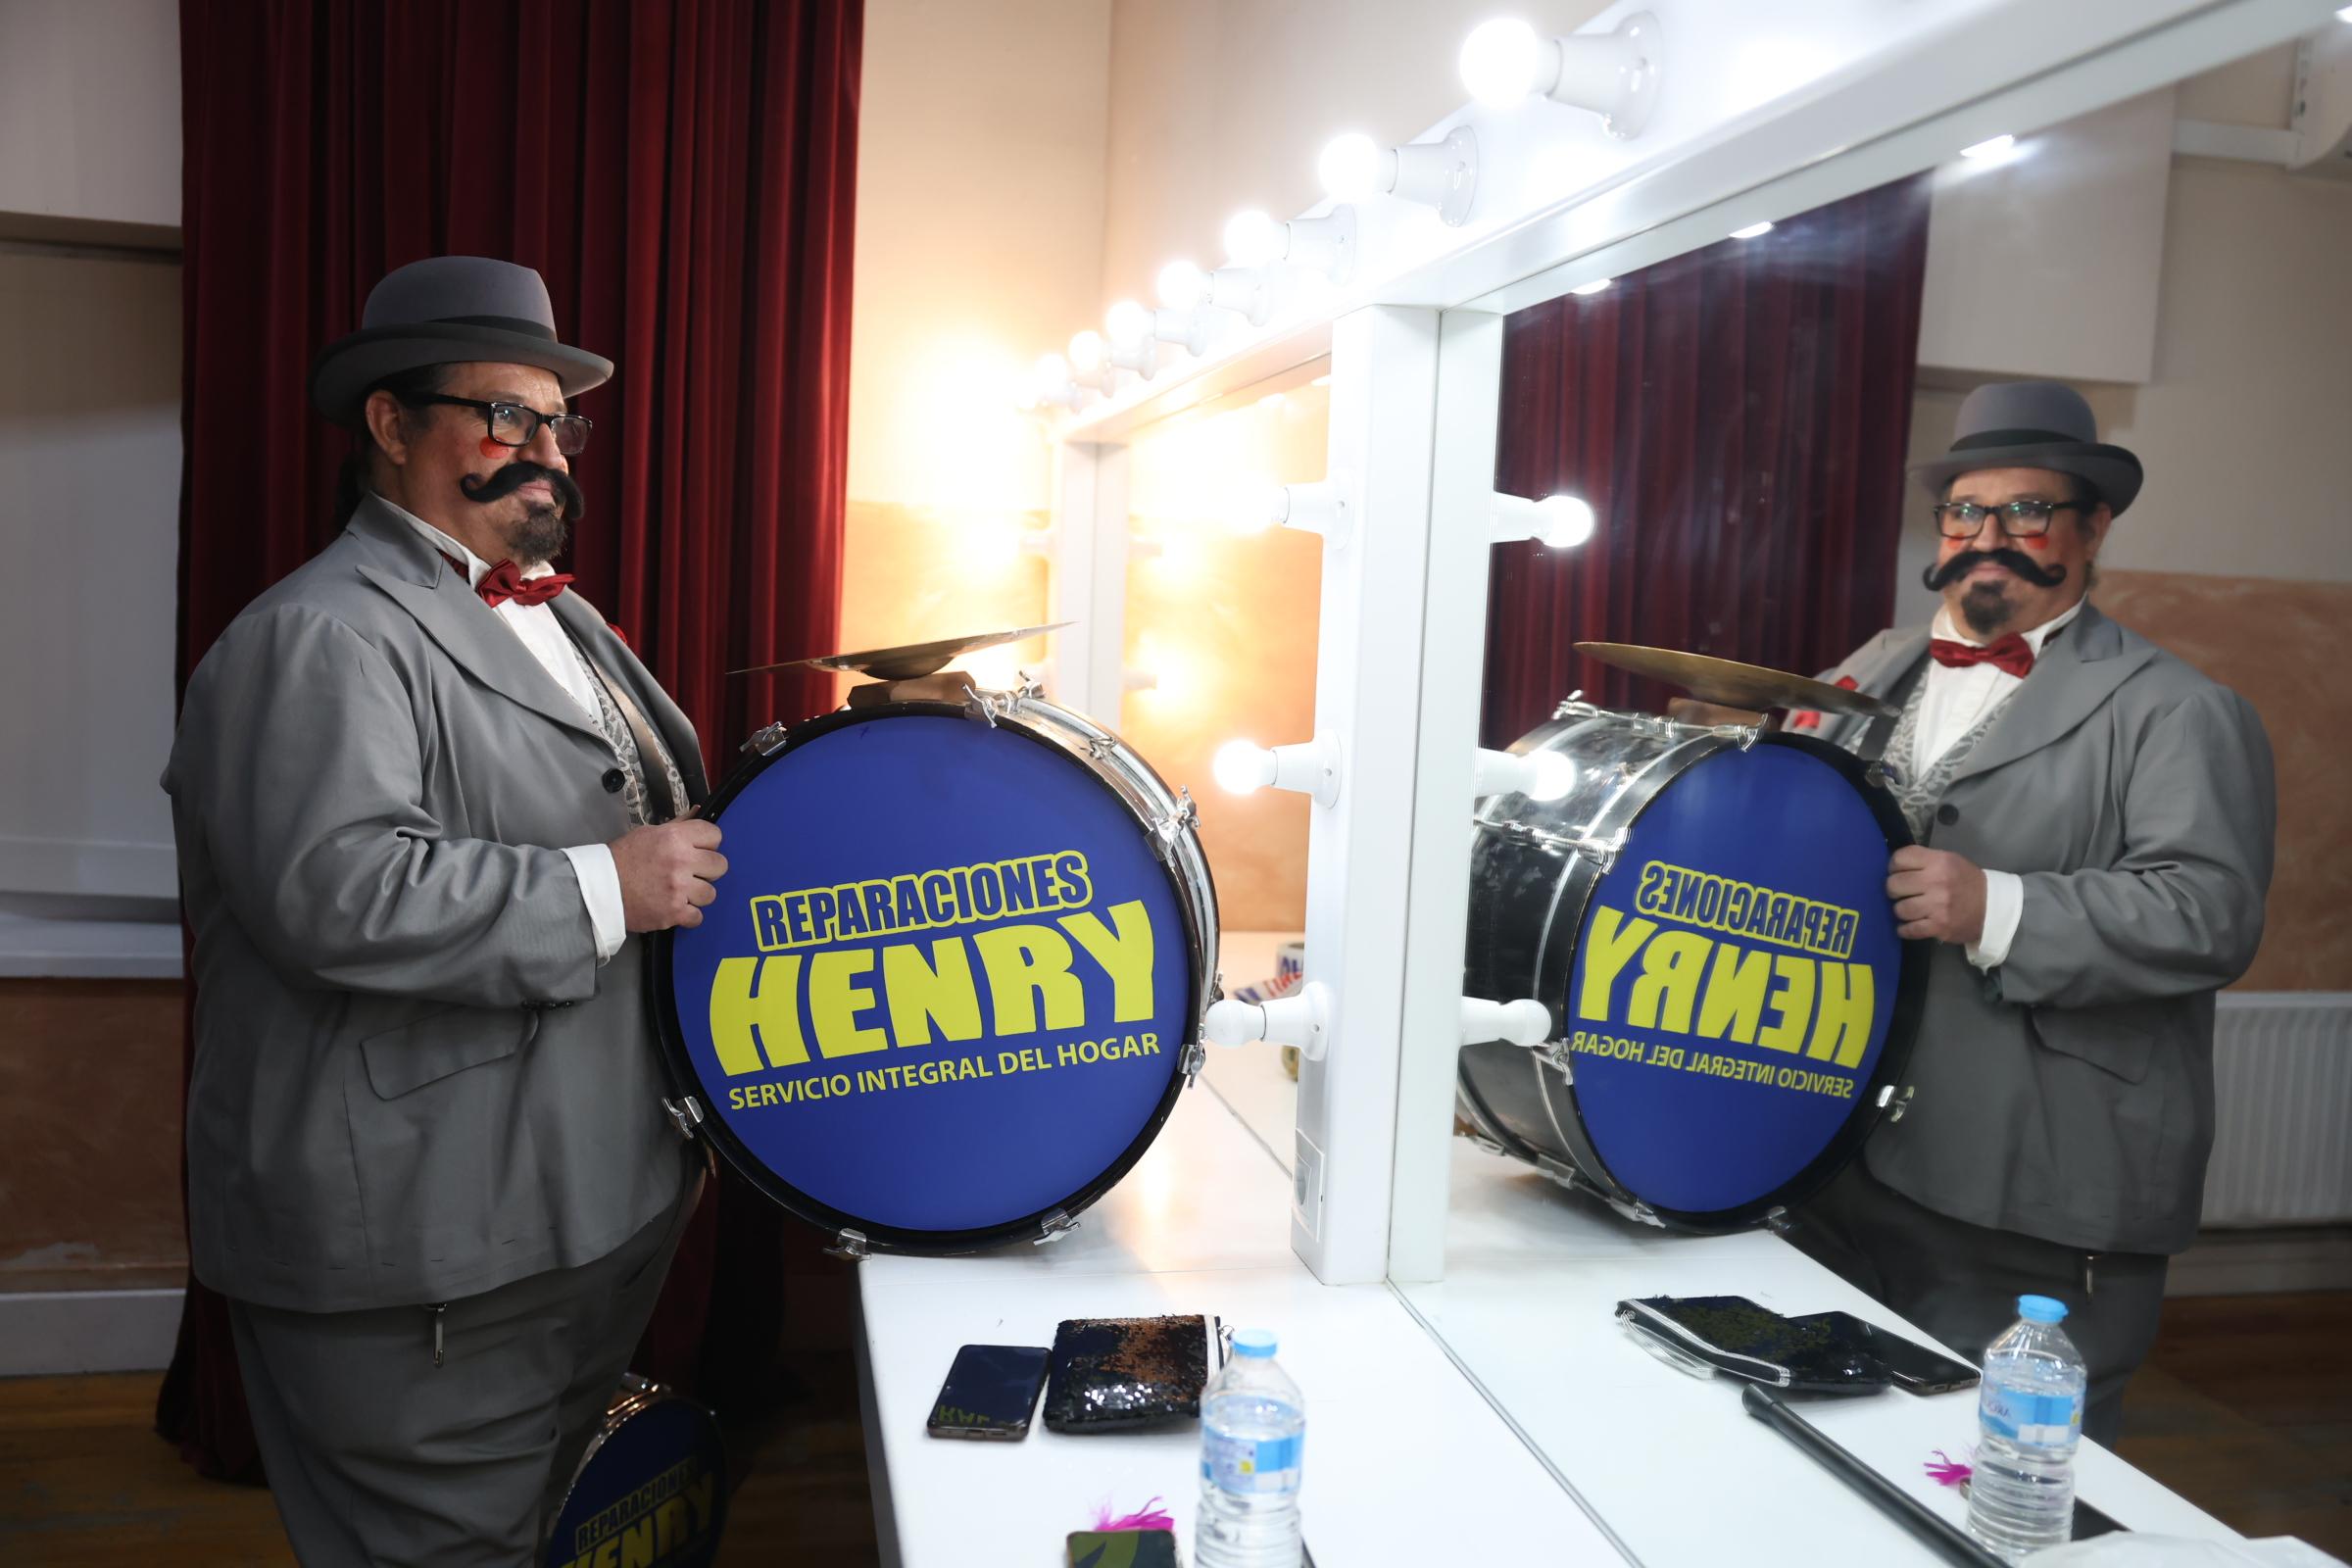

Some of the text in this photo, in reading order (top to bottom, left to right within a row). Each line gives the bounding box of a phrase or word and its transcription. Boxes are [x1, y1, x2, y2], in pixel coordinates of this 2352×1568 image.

[750, 851, 1094, 952] REPARACIONES
[710, 901, 1154, 1076] HENRY
[729, 1033, 1159, 1109] SERVICIO INTEGRAL DEL HOGAR
